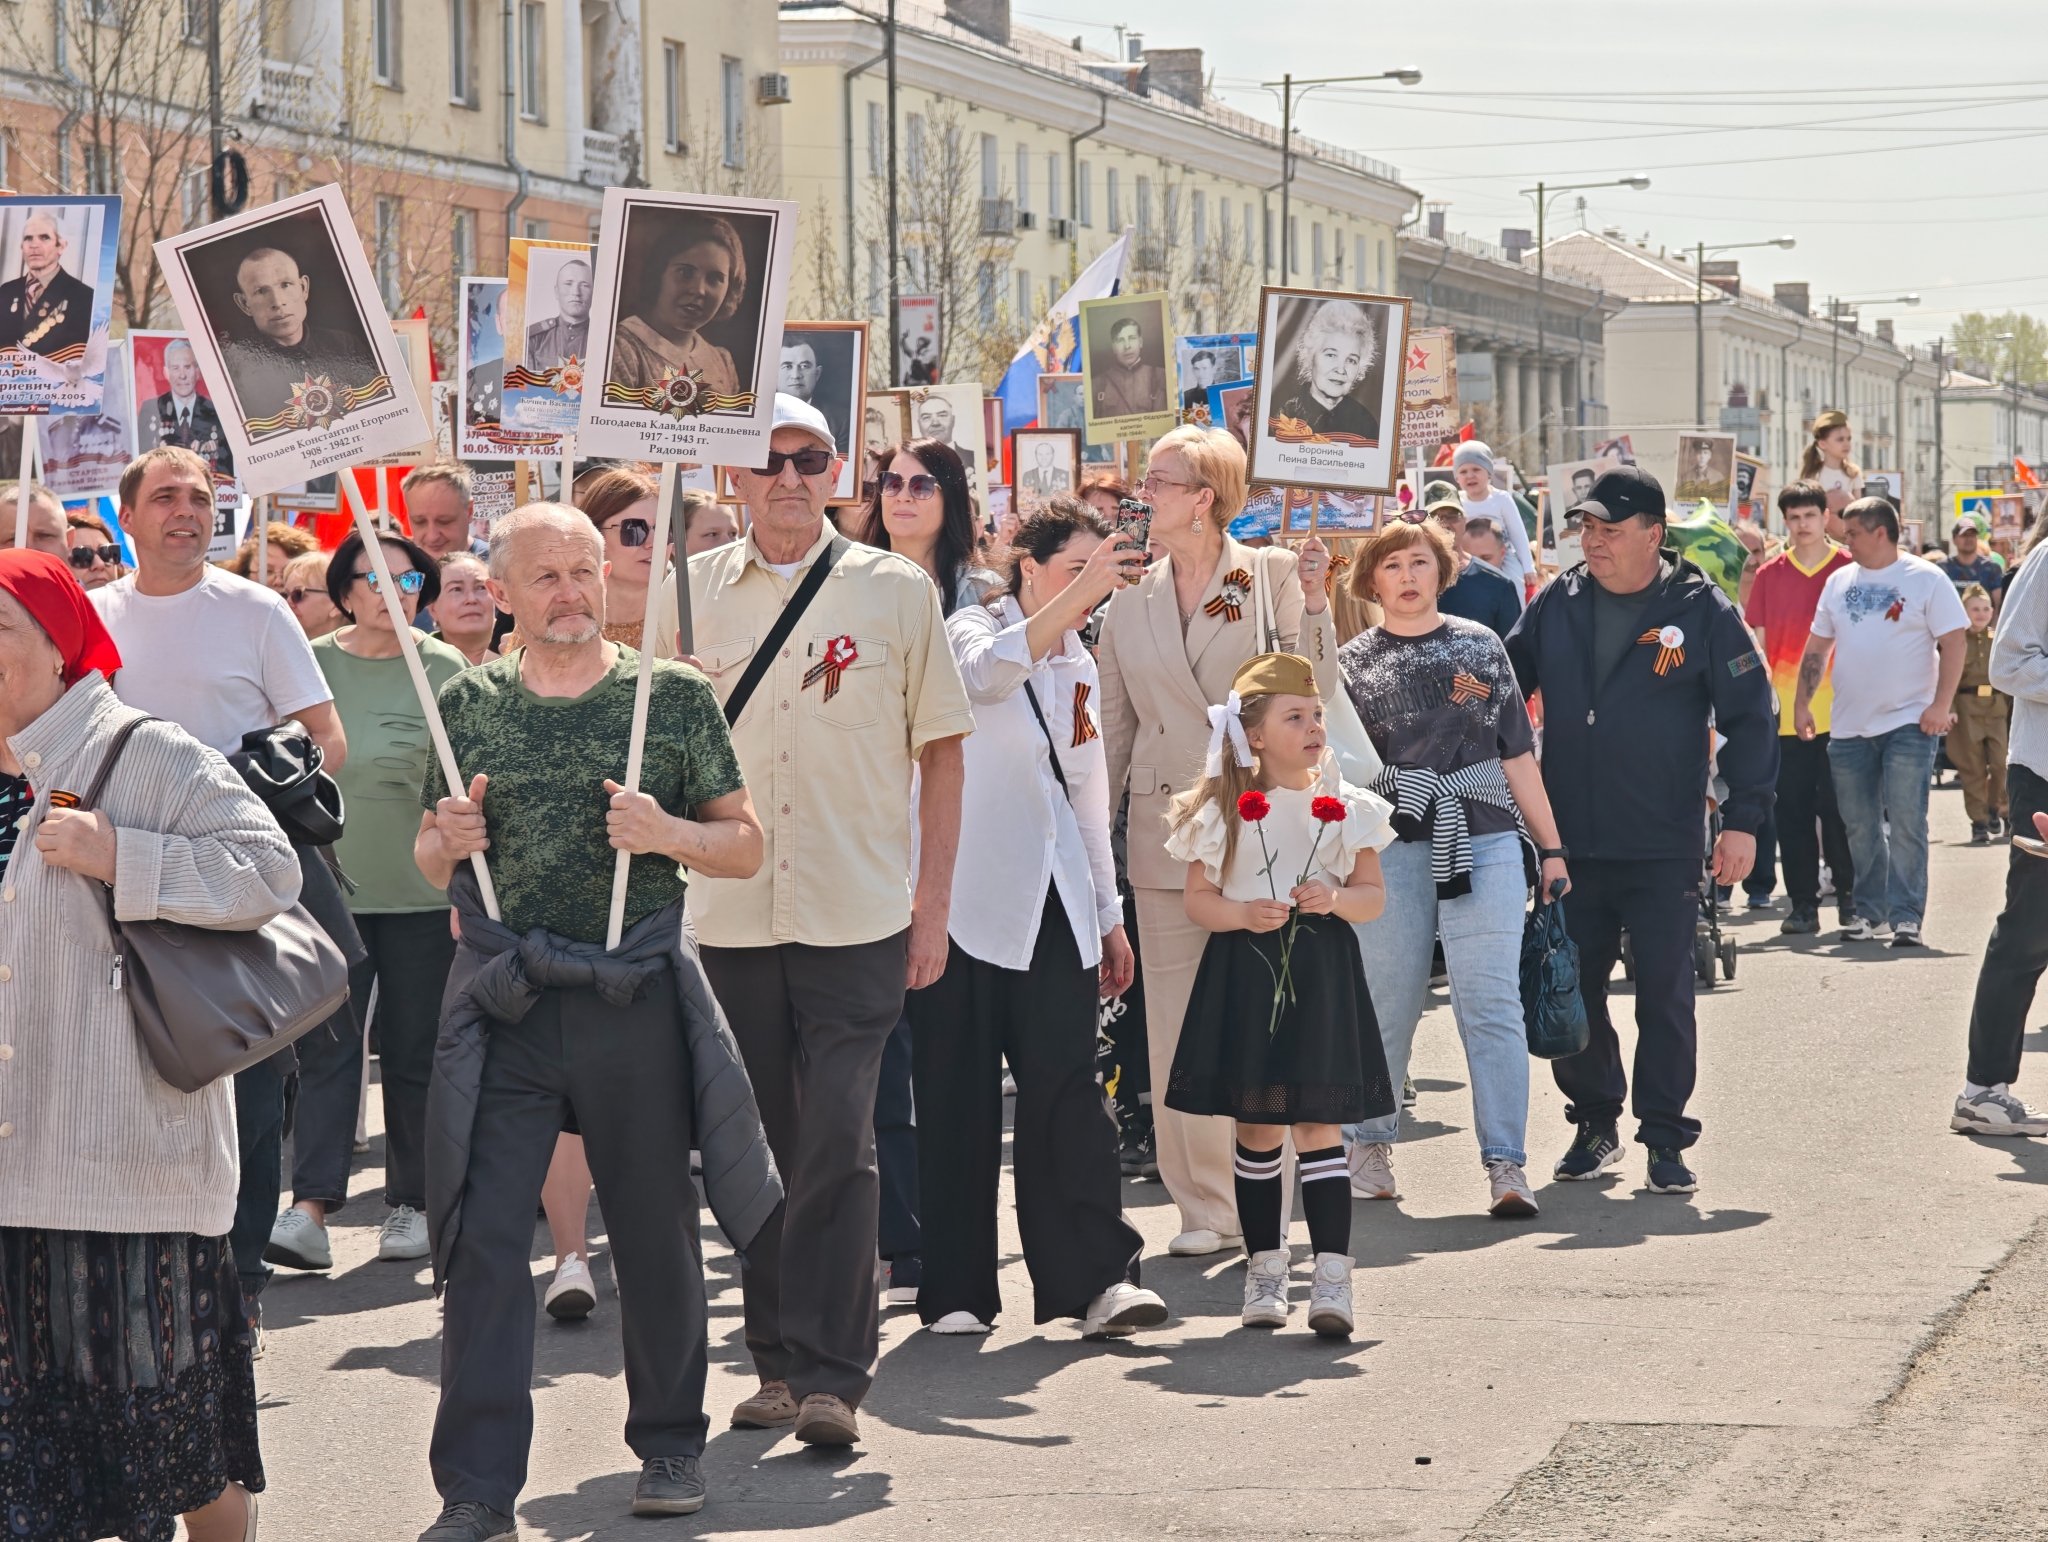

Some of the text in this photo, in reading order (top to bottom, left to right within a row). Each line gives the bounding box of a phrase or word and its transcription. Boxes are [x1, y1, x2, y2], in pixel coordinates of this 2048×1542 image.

[1404, 388, 1432, 398] полк
[590, 415, 648, 429] Погодаева
[650, 419, 696, 433] Клавдия
[699, 423, 761, 437] Васильевна
[247, 406, 410, 466] Погодаев Константин Егорович
[640, 431, 663, 442] 1917
[672, 433, 694, 444] 1943
[696, 436, 709, 445] гг.
[301, 445, 322, 460] 1908
[329, 437, 351, 452] 1942
[351, 434, 365, 445] гг.
[463, 443, 514, 455] 10.05.1918
[649, 444, 697, 456] Рядовой
[1298, 445, 1344, 457] Воронина
[310, 445, 365, 470] Лейтенант
[1310, 456, 1365, 469] Васильевна
